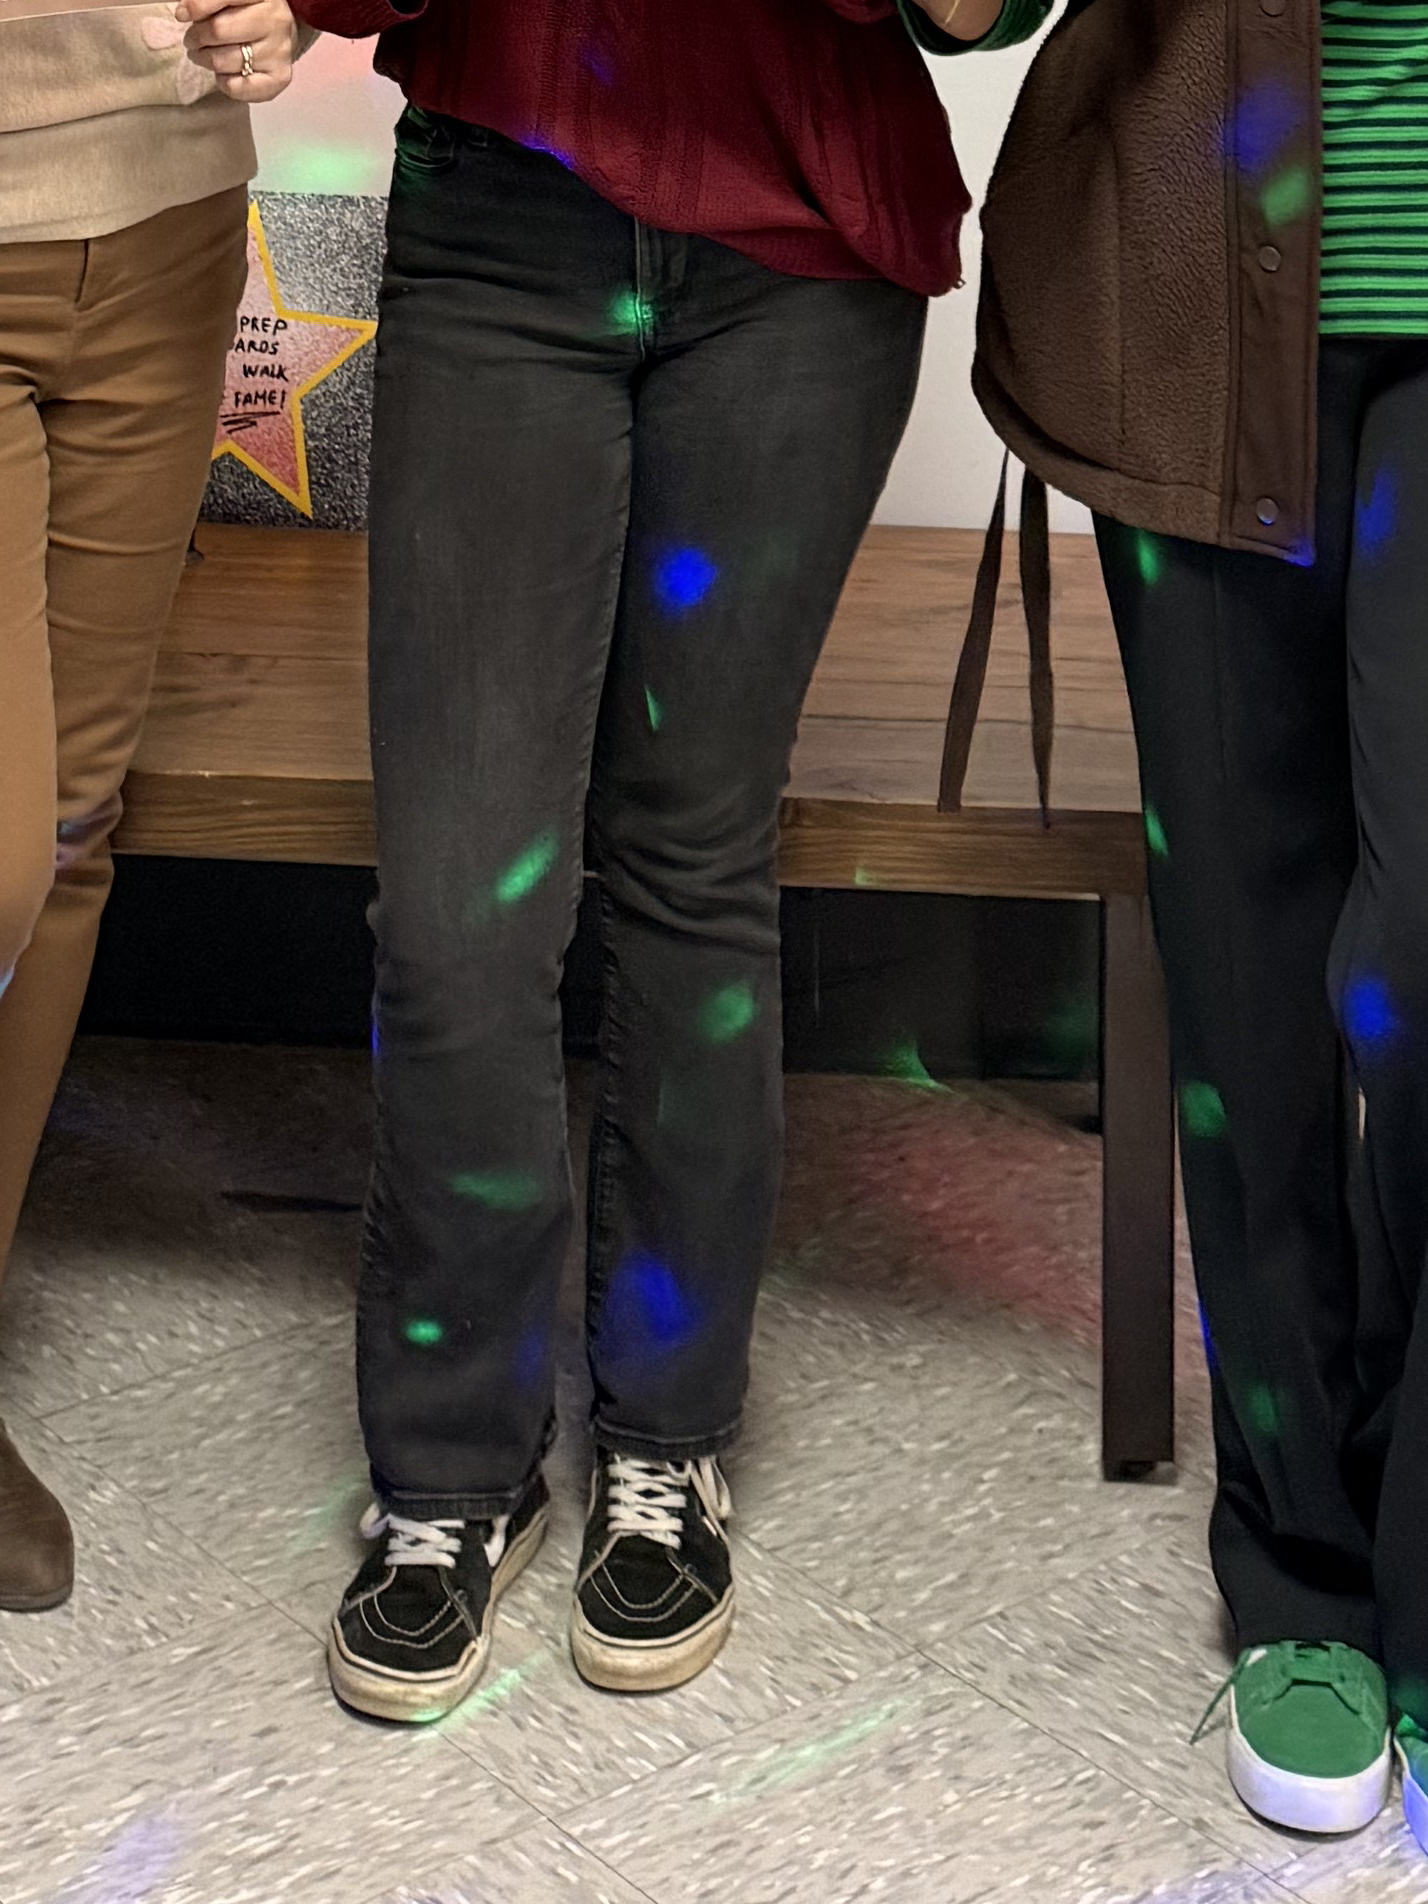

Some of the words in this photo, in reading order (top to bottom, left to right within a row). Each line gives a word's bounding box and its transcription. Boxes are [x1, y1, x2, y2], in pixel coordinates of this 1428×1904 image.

[240, 315, 287, 335] PREP
[234, 338, 280, 355] ARDS
[242, 363, 289, 382] WALK
[234, 389, 286, 409] FAME!
